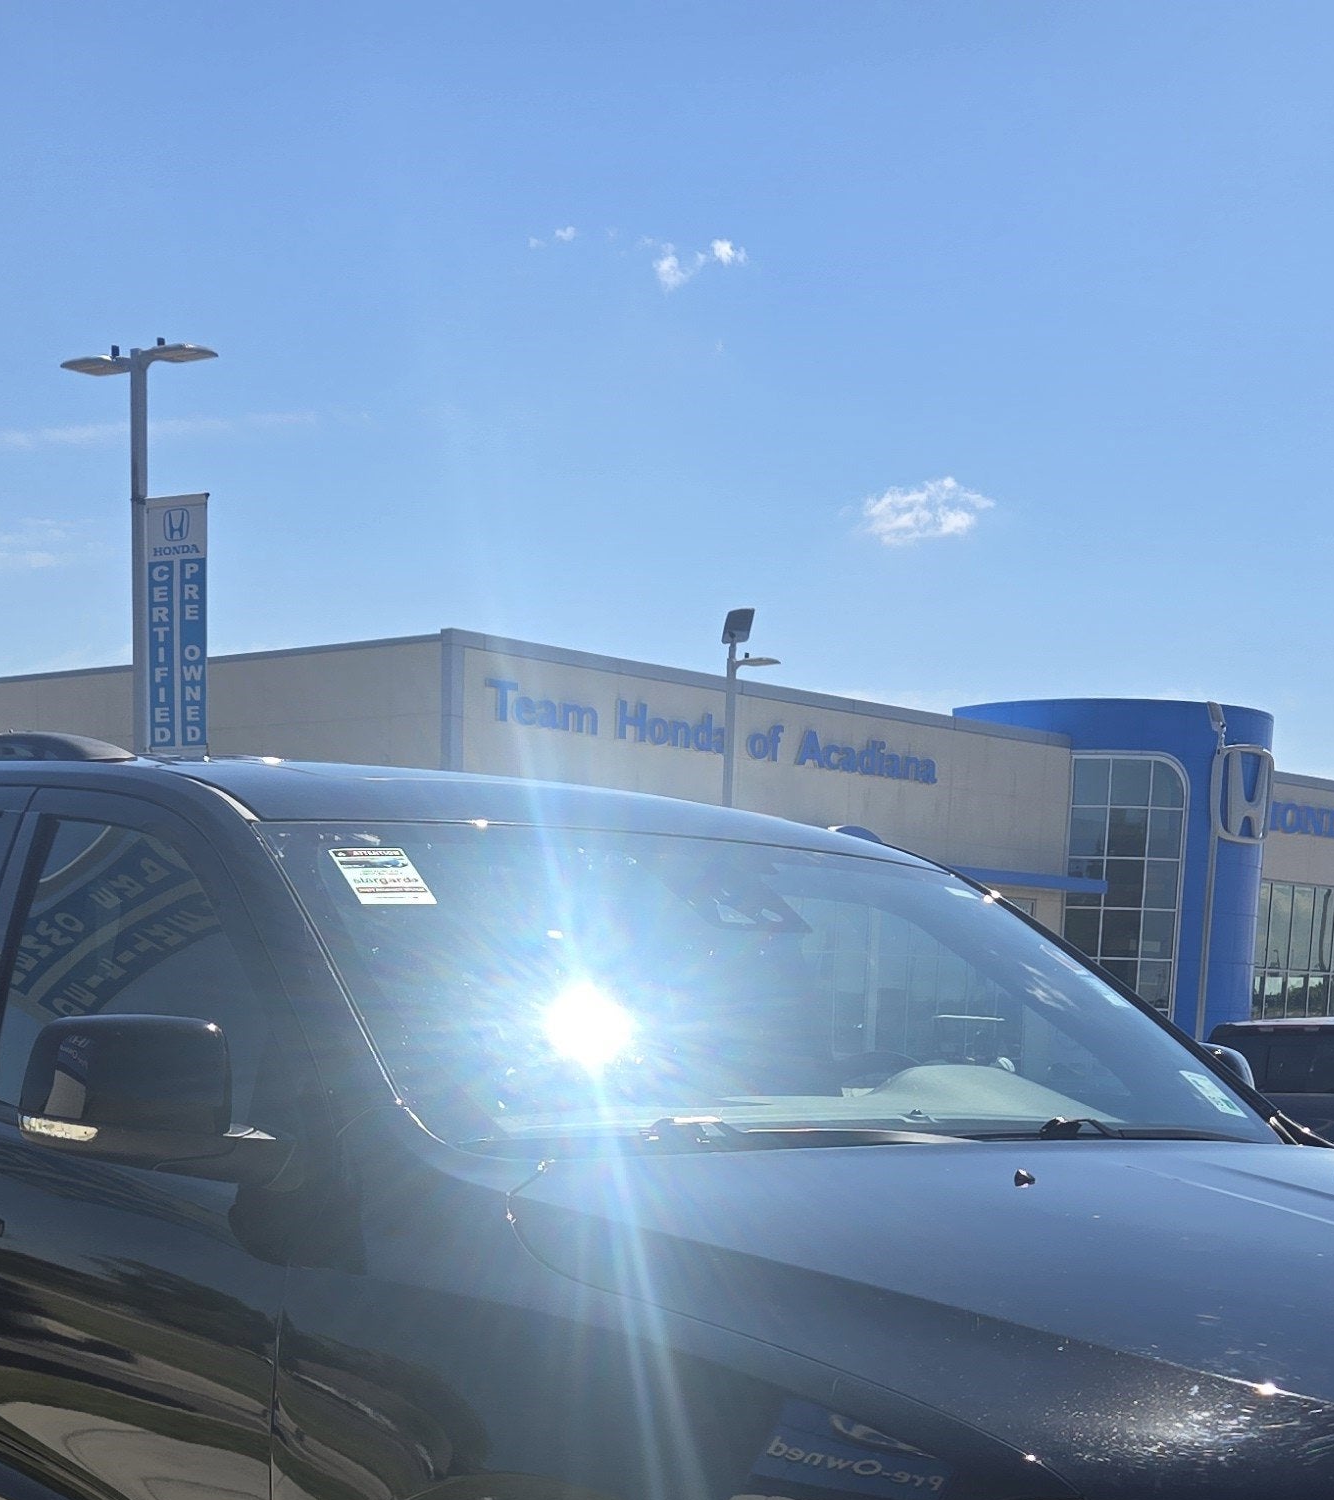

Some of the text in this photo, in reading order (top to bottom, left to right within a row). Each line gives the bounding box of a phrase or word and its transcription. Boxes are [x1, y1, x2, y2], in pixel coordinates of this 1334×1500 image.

[153, 543, 200, 557] HONDA
[152, 565, 171, 744] CERTIFIED
[182, 562, 203, 742] PRE OWNED
[485, 677, 598, 735] Team
[747, 723, 784, 763] of
[796, 729, 939, 785] Acadiana
